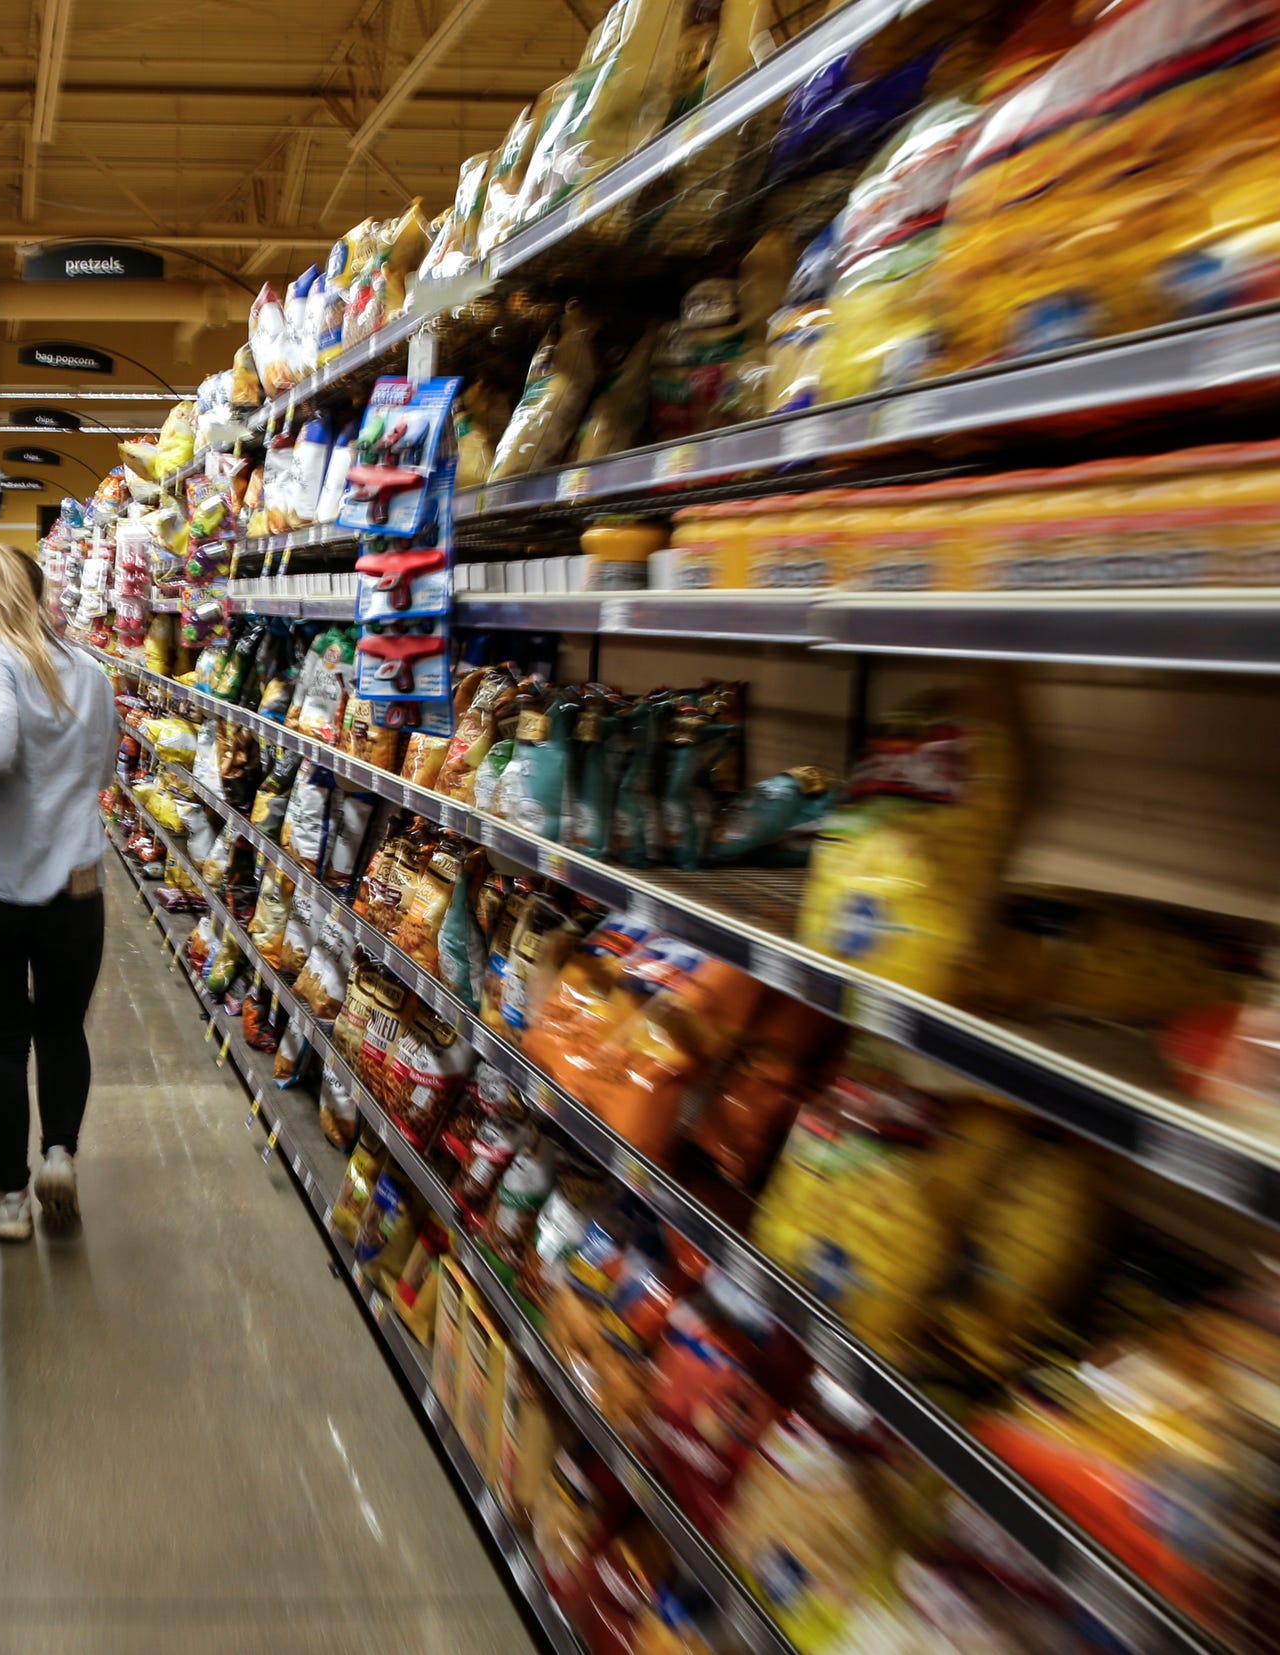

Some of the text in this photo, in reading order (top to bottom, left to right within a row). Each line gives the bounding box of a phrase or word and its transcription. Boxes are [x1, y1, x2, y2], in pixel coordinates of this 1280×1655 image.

[64, 256, 125, 277] pretzels
[35, 350, 101, 369] bag popcorn
[34, 415, 61, 427] chips
[23, 452, 44, 462] chips
